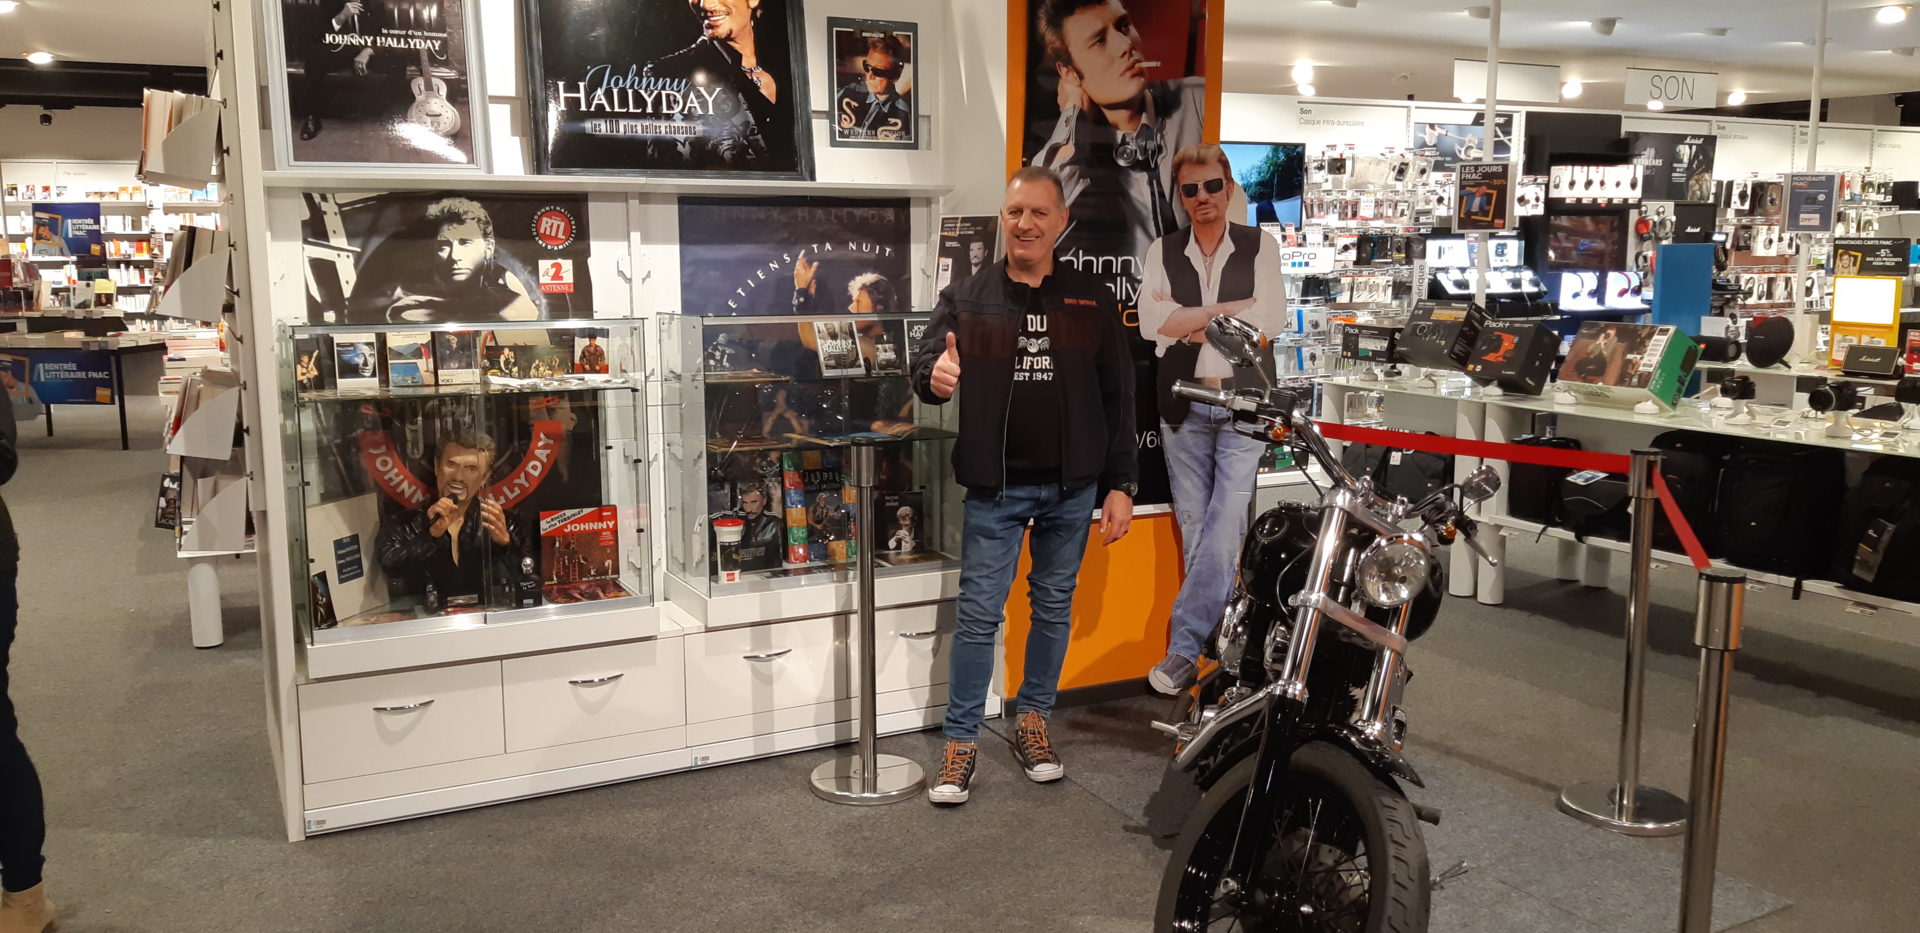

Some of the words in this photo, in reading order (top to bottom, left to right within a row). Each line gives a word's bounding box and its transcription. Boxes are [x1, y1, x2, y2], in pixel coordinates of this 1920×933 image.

[423, 30, 447, 38] homme
[322, 33, 374, 50] JOHNNY
[376, 36, 444, 55] HALLYDAY
[585, 64, 692, 102] Johnny
[1649, 74, 1695, 101] SON
[557, 81, 723, 115] HALLYDAY
[1299, 107, 1312, 115] Son
[590, 121, 602, 133] les
[604, 119, 621, 134] 100
[623, 123, 638, 136] plus
[640, 122, 662, 135] belles
[664, 124, 697, 136] chansons
[1476, 165, 1503, 173] JOURS
[540, 216, 566, 240] RTL
[811, 242, 833, 254] TA
[848, 241, 893, 257] NUIT
[1281, 251, 1317, 260] oPro
[540, 283, 570, 292] ANTENNE
[1026, 314, 1048, 332] DU
[1484, 320, 1511, 328] Pack+
[1344, 326, 1360, 334] Pack
[44, 362, 77, 371] RENTRÉE
[45, 370, 87, 379] LITTÉRAIRE
[88, 371, 110, 379] FNAC
[1013, 371, 1031, 381] EST
[1032, 371, 1054, 381] 1947
[368, 444, 431, 504] JOHNN
[486, 431, 554, 506] LLYDAY
[563, 520, 616, 533] JOHNNY
